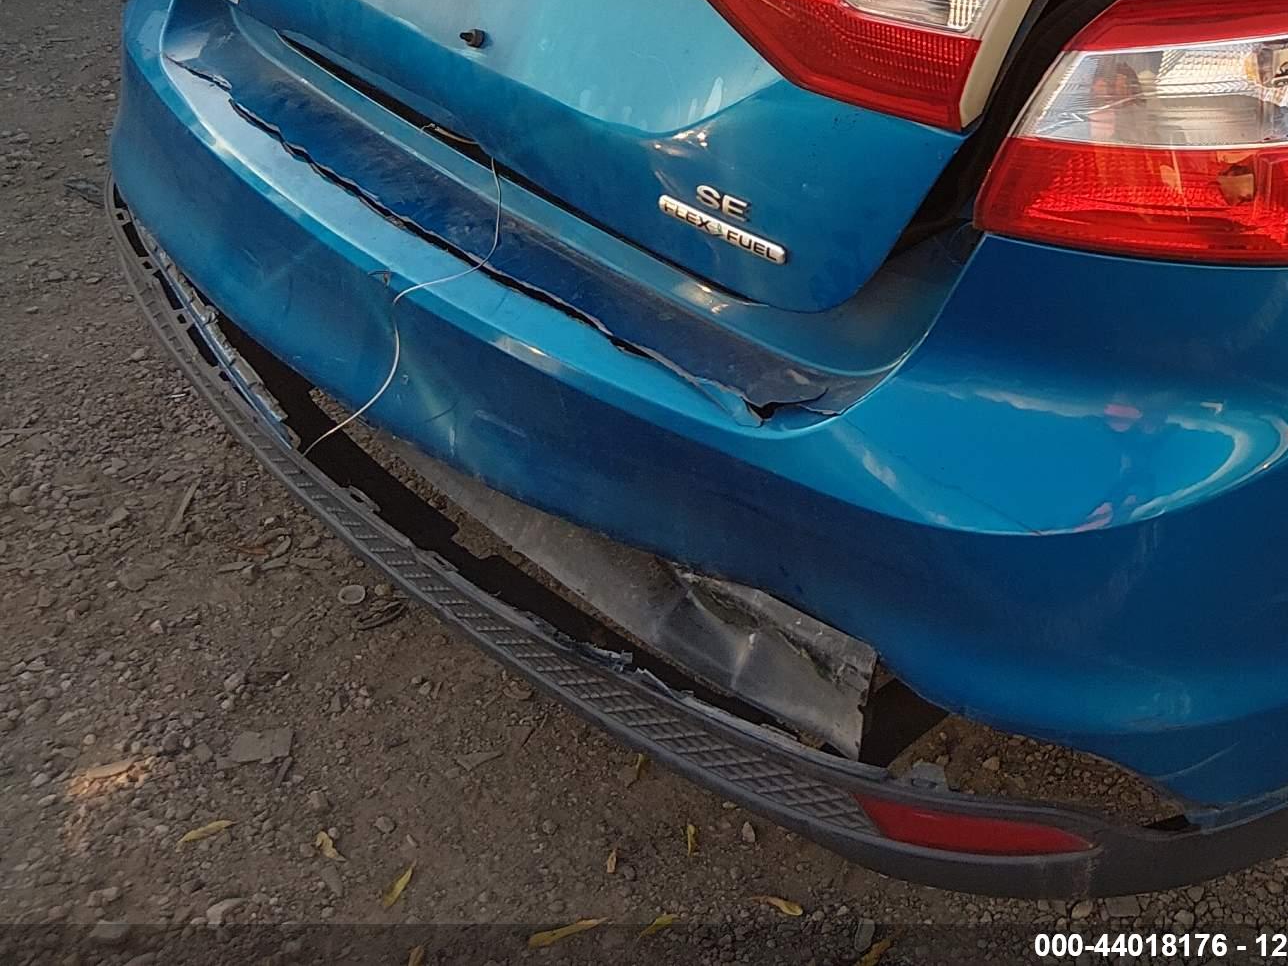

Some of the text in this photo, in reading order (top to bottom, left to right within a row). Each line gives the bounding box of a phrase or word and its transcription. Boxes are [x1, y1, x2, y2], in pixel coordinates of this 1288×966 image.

[696, 184, 749, 222] SE
[663, 199, 777, 261] FLEX FUEL
